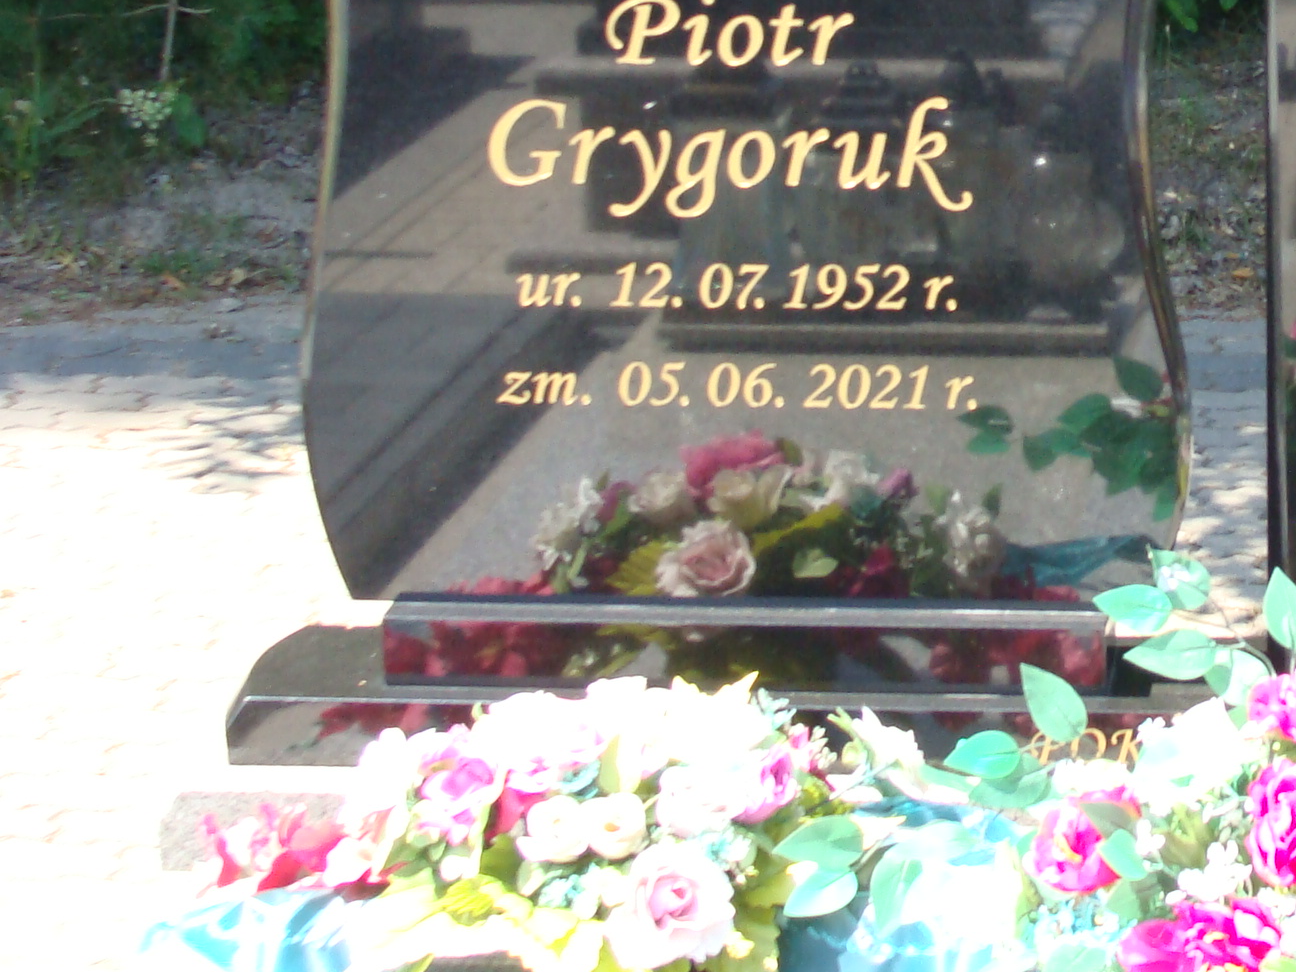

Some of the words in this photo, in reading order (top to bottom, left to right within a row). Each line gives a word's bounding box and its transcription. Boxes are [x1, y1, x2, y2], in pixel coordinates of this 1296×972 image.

[486, 96, 975, 220] Grygoruk
[516, 273, 583, 309] ur.
[610, 261, 683, 309] 12.
[697, 262, 766, 310] 07.
[783, 263, 911, 311] 1952
[924, 275, 959, 312] r.
[495, 370, 591, 407] zm.
[617, 361, 690, 408] 05.
[705, 361, 785, 409] 06.
[802, 362, 930, 411] 2021
[946, 375, 979, 412] r.
